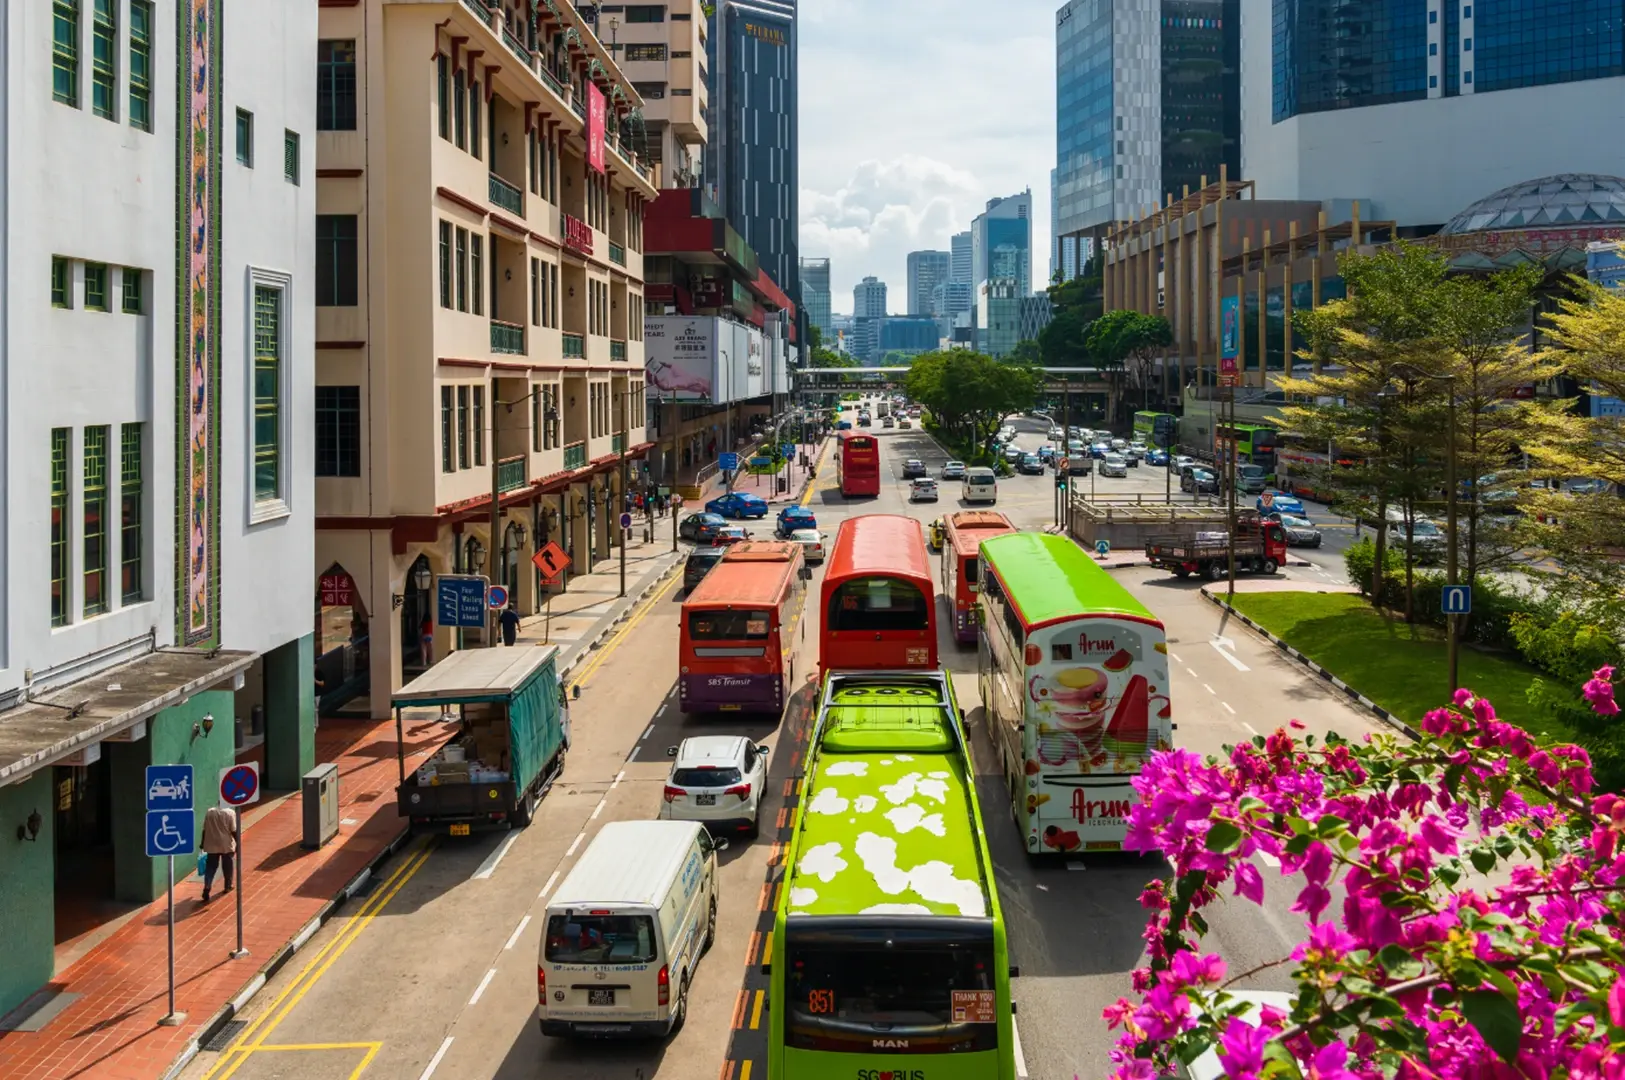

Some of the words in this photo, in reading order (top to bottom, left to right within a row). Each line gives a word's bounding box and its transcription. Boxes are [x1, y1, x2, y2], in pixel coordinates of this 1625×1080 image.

[1078, 632, 1115, 655] Arun
[722, 677, 751, 686] Transit
[1069, 787, 1131, 825] Arun
[808, 989, 835, 1013] 851
[954, 992, 977, 1001] THANK
[979, 992, 993, 1001] YOU
[872, 1039, 909, 1048] MAN
